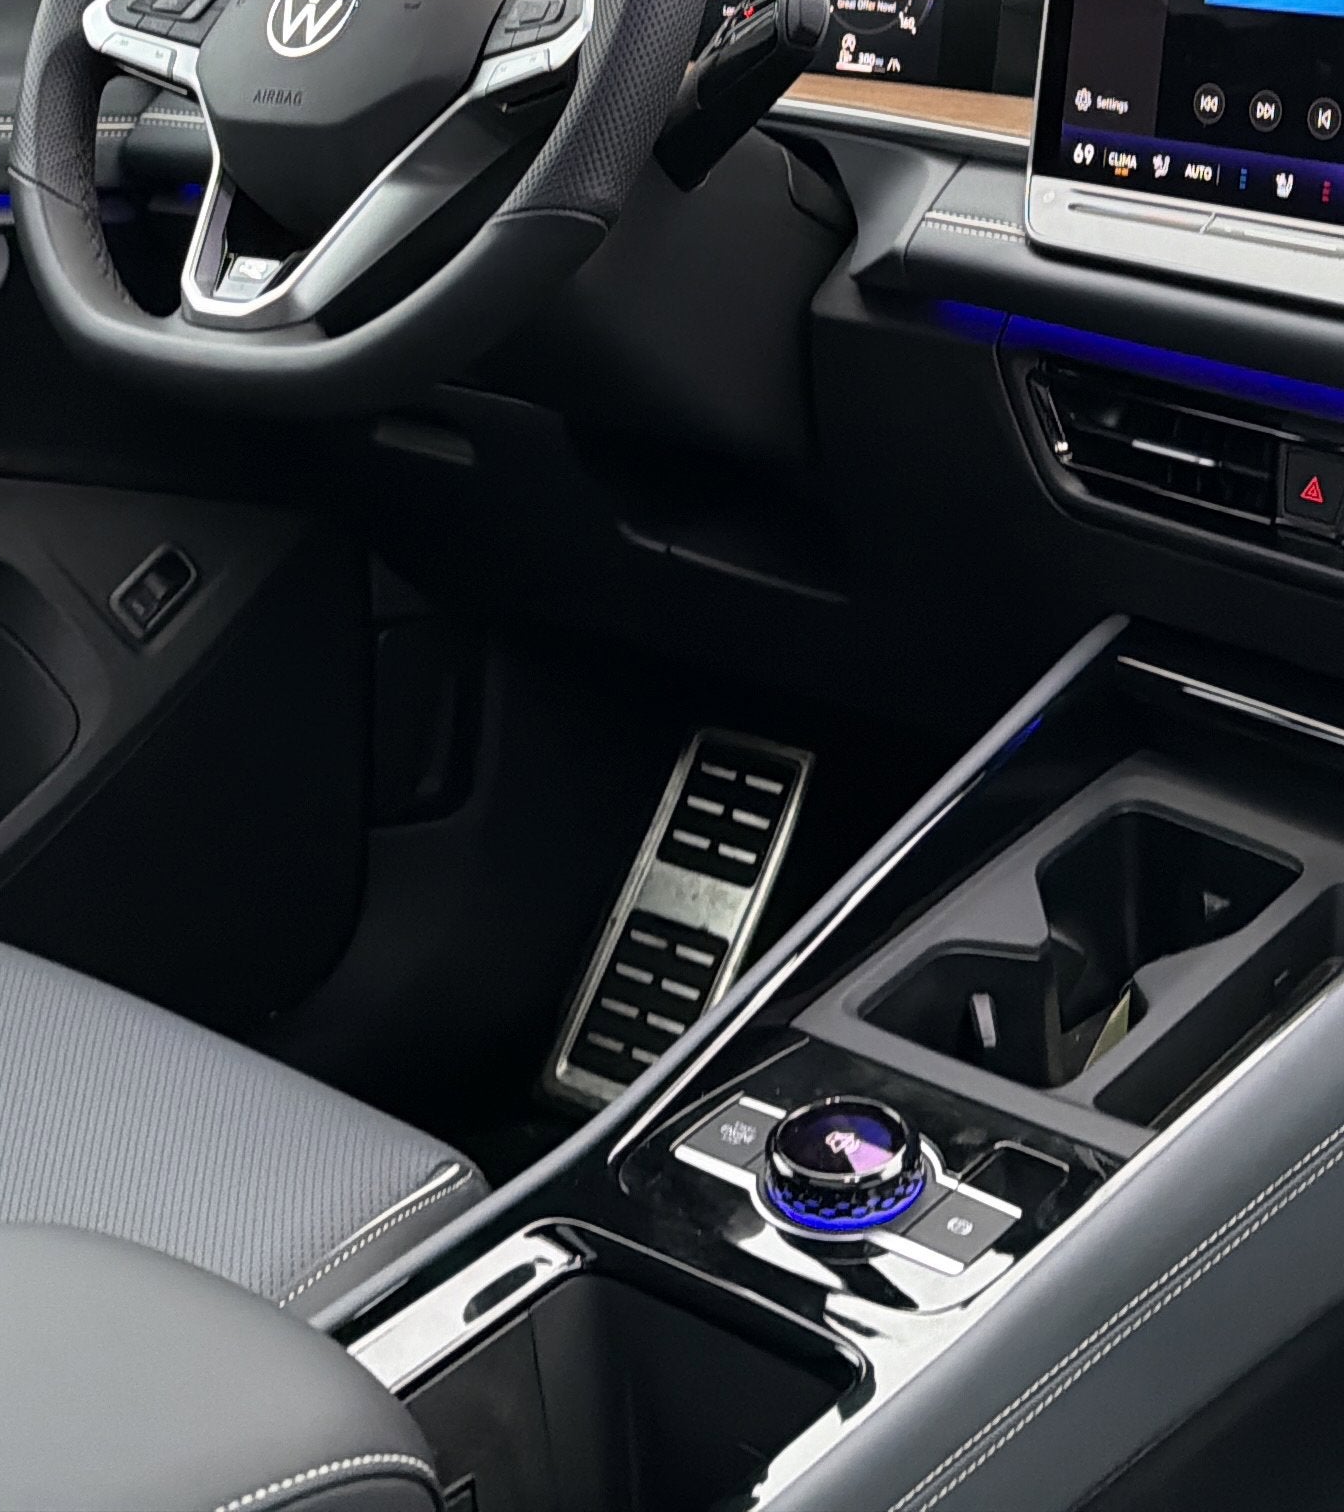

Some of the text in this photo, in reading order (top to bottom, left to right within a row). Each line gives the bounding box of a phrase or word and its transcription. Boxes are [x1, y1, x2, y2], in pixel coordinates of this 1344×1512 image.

[253, 88, 303, 105] AIRBAG
[1096, 95, 1129, 115] Settings
[1073, 143, 1095, 166] 69
[1108, 151, 1137, 170] CLIMA
[1184, 163, 1213, 182] AUTO
